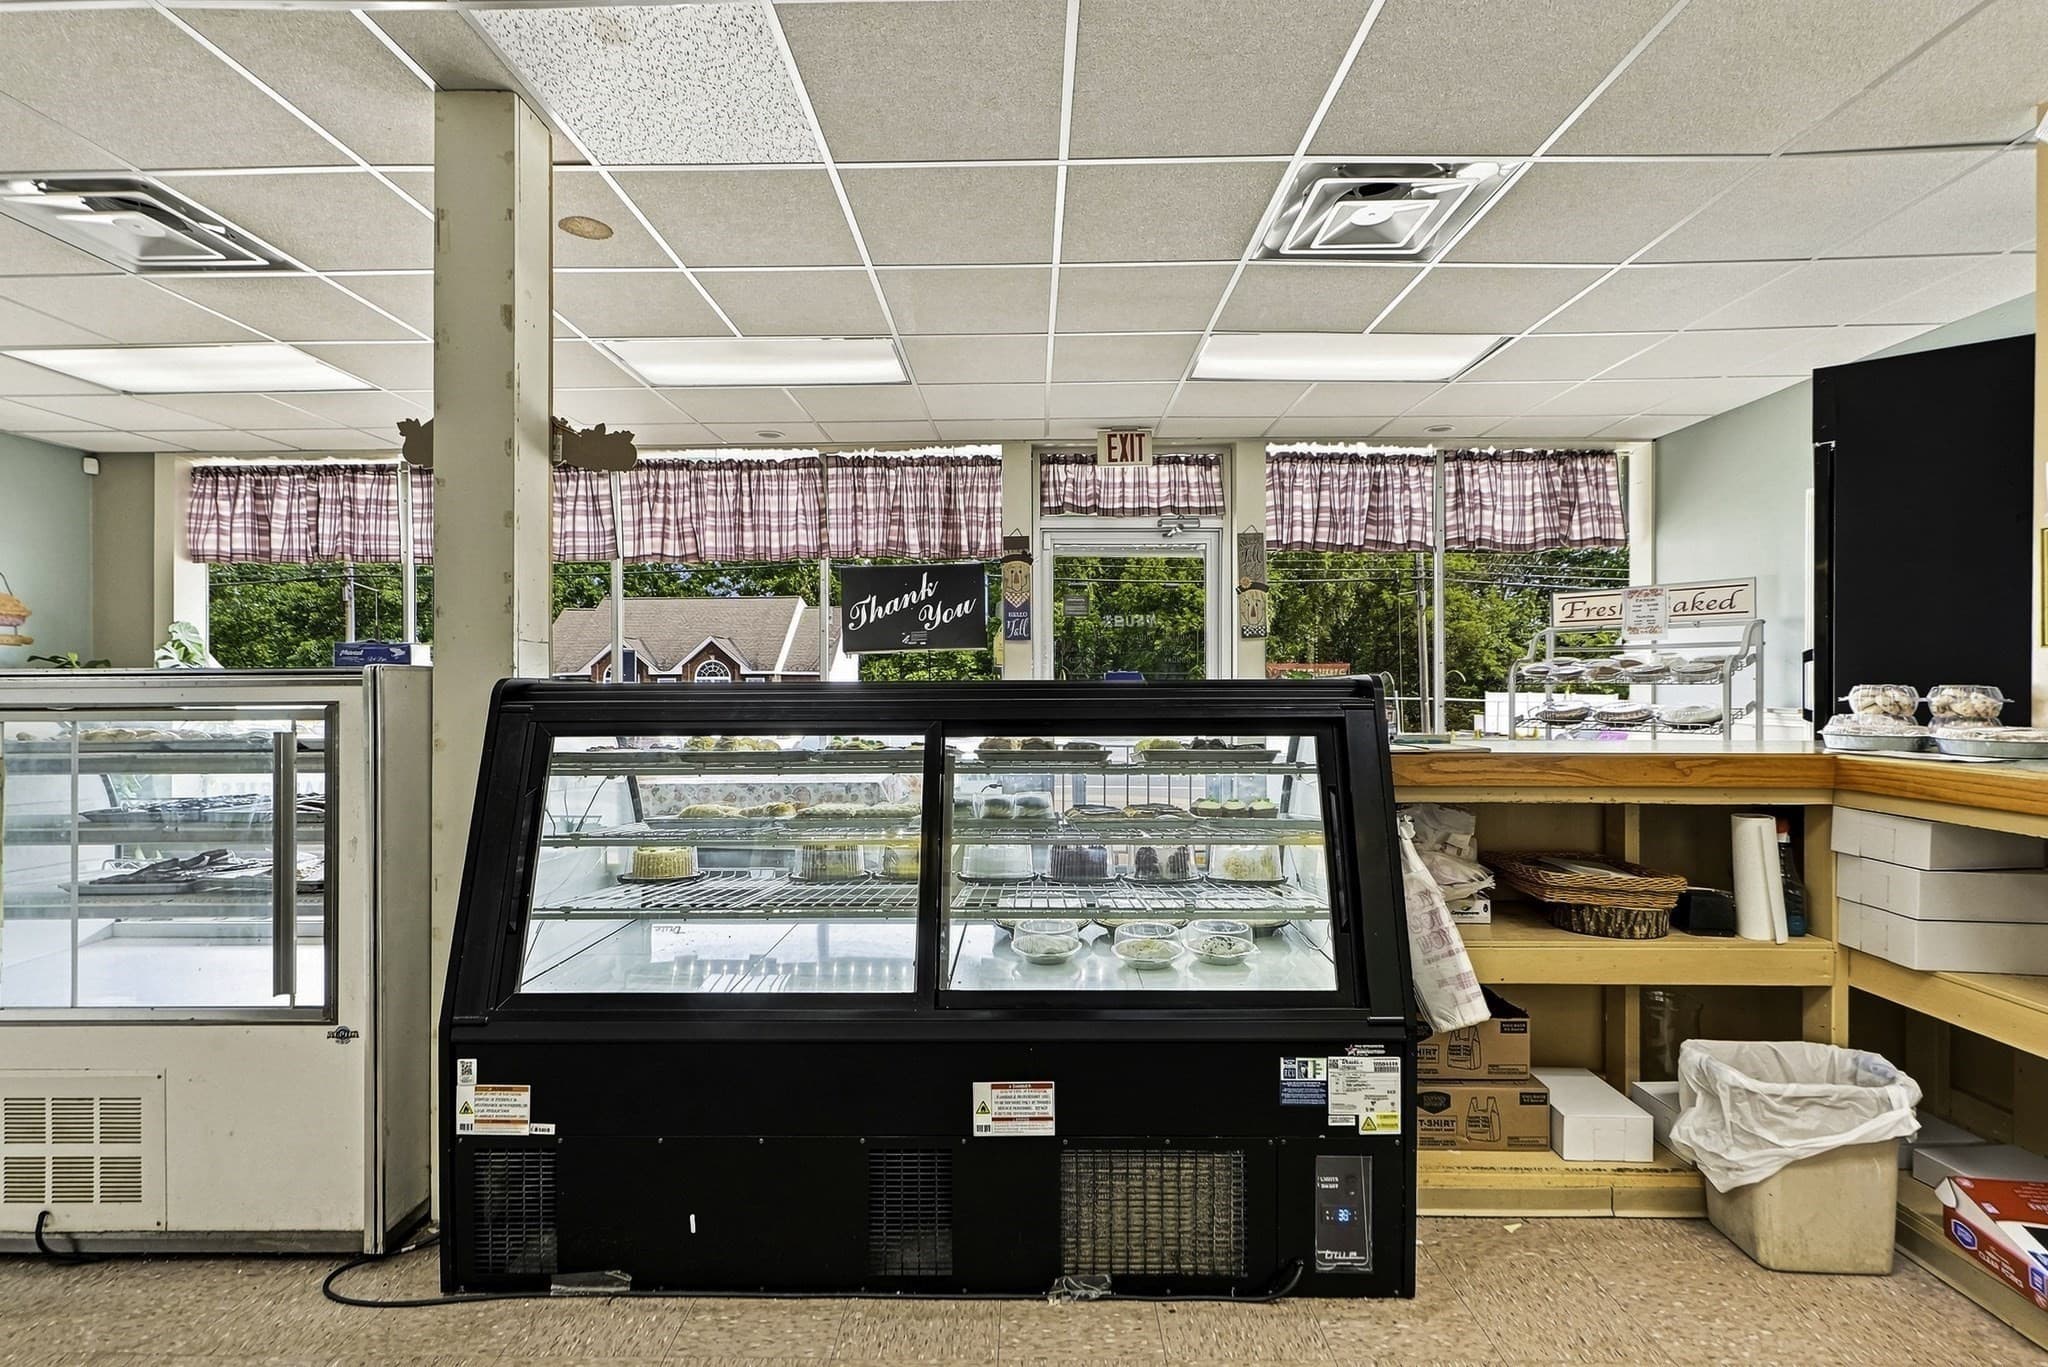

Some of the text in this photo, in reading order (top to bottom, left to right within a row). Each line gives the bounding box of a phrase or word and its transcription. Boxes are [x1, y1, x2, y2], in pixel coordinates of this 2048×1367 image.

[1107, 433, 1145, 462] EXIT
[848, 571, 977, 631] Thank You
[1672, 589, 1745, 613] aked
[1418, 1119, 1456, 1128] T-SHIRT
